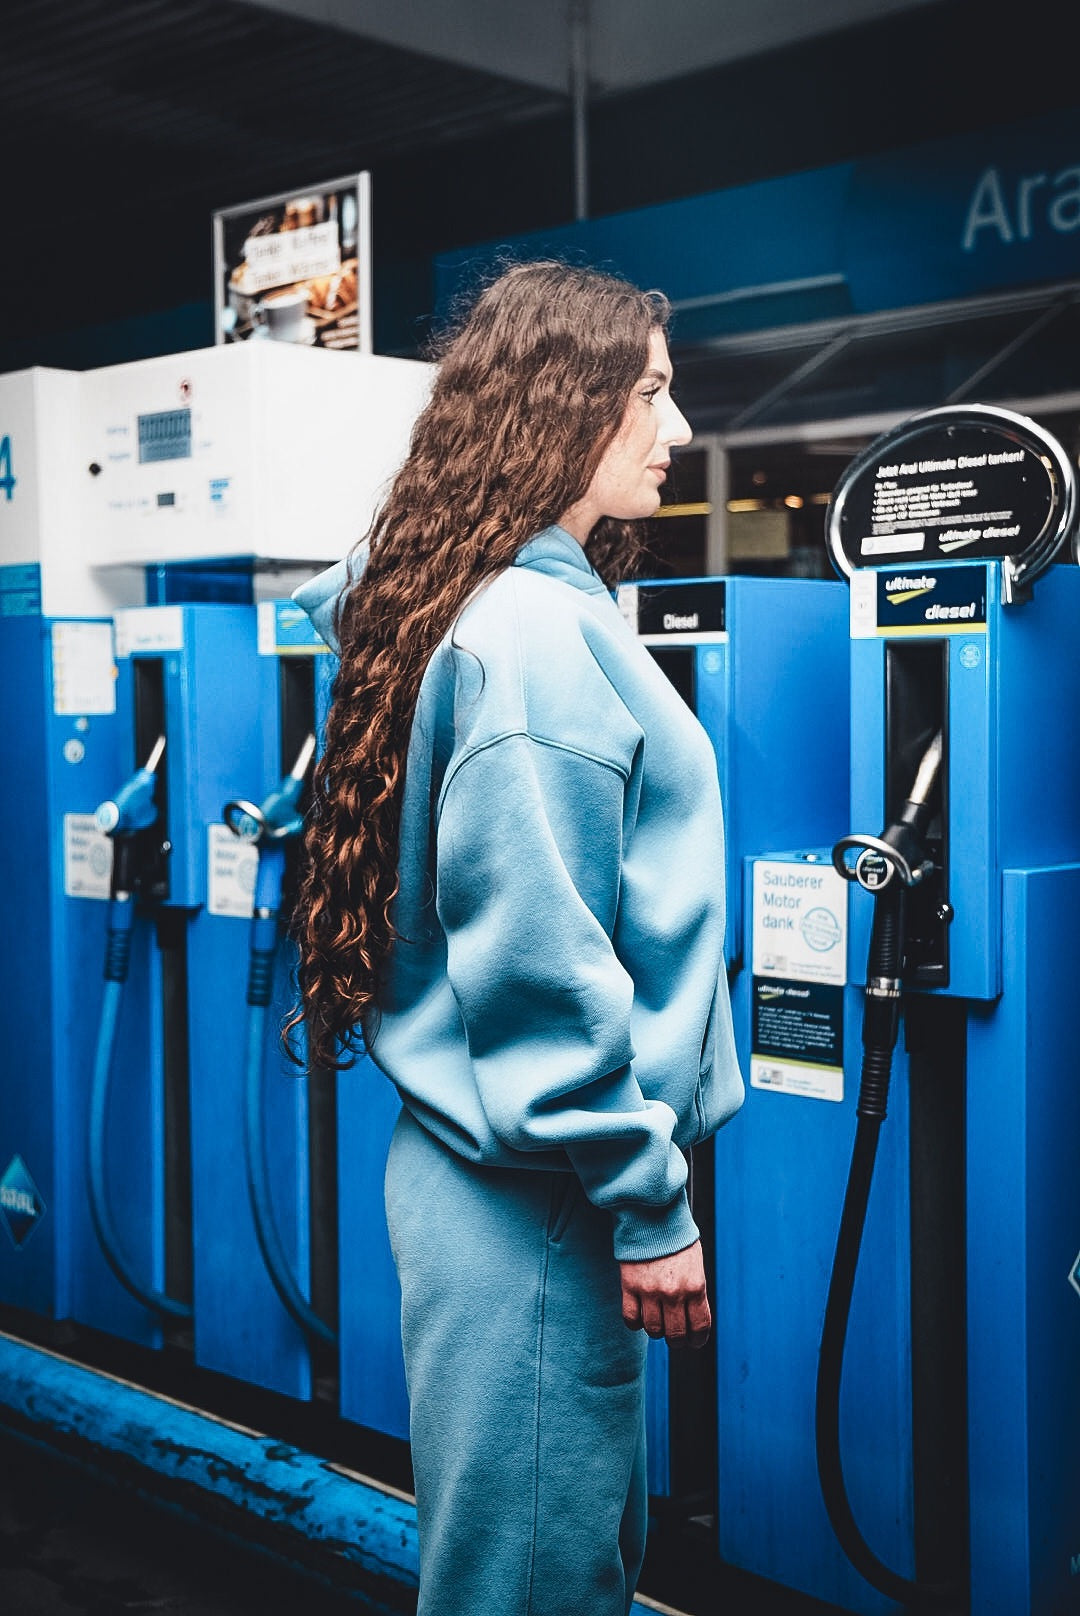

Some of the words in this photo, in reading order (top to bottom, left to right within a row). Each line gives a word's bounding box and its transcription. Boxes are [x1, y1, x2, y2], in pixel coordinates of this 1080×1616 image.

[964, 169, 1080, 249] Ara
[957, 454, 987, 469] Diesel
[939, 528, 981, 542] ultimate
[982, 524, 1020, 538] diesel
[885, 575, 937, 591] ultimate
[925, 602, 976, 620] diesel
[663, 612, 699, 630] Diesel
[763, 870, 823, 889] Sauberer
[763, 892, 802, 909] Motor
[762, 914, 794, 930] dank
